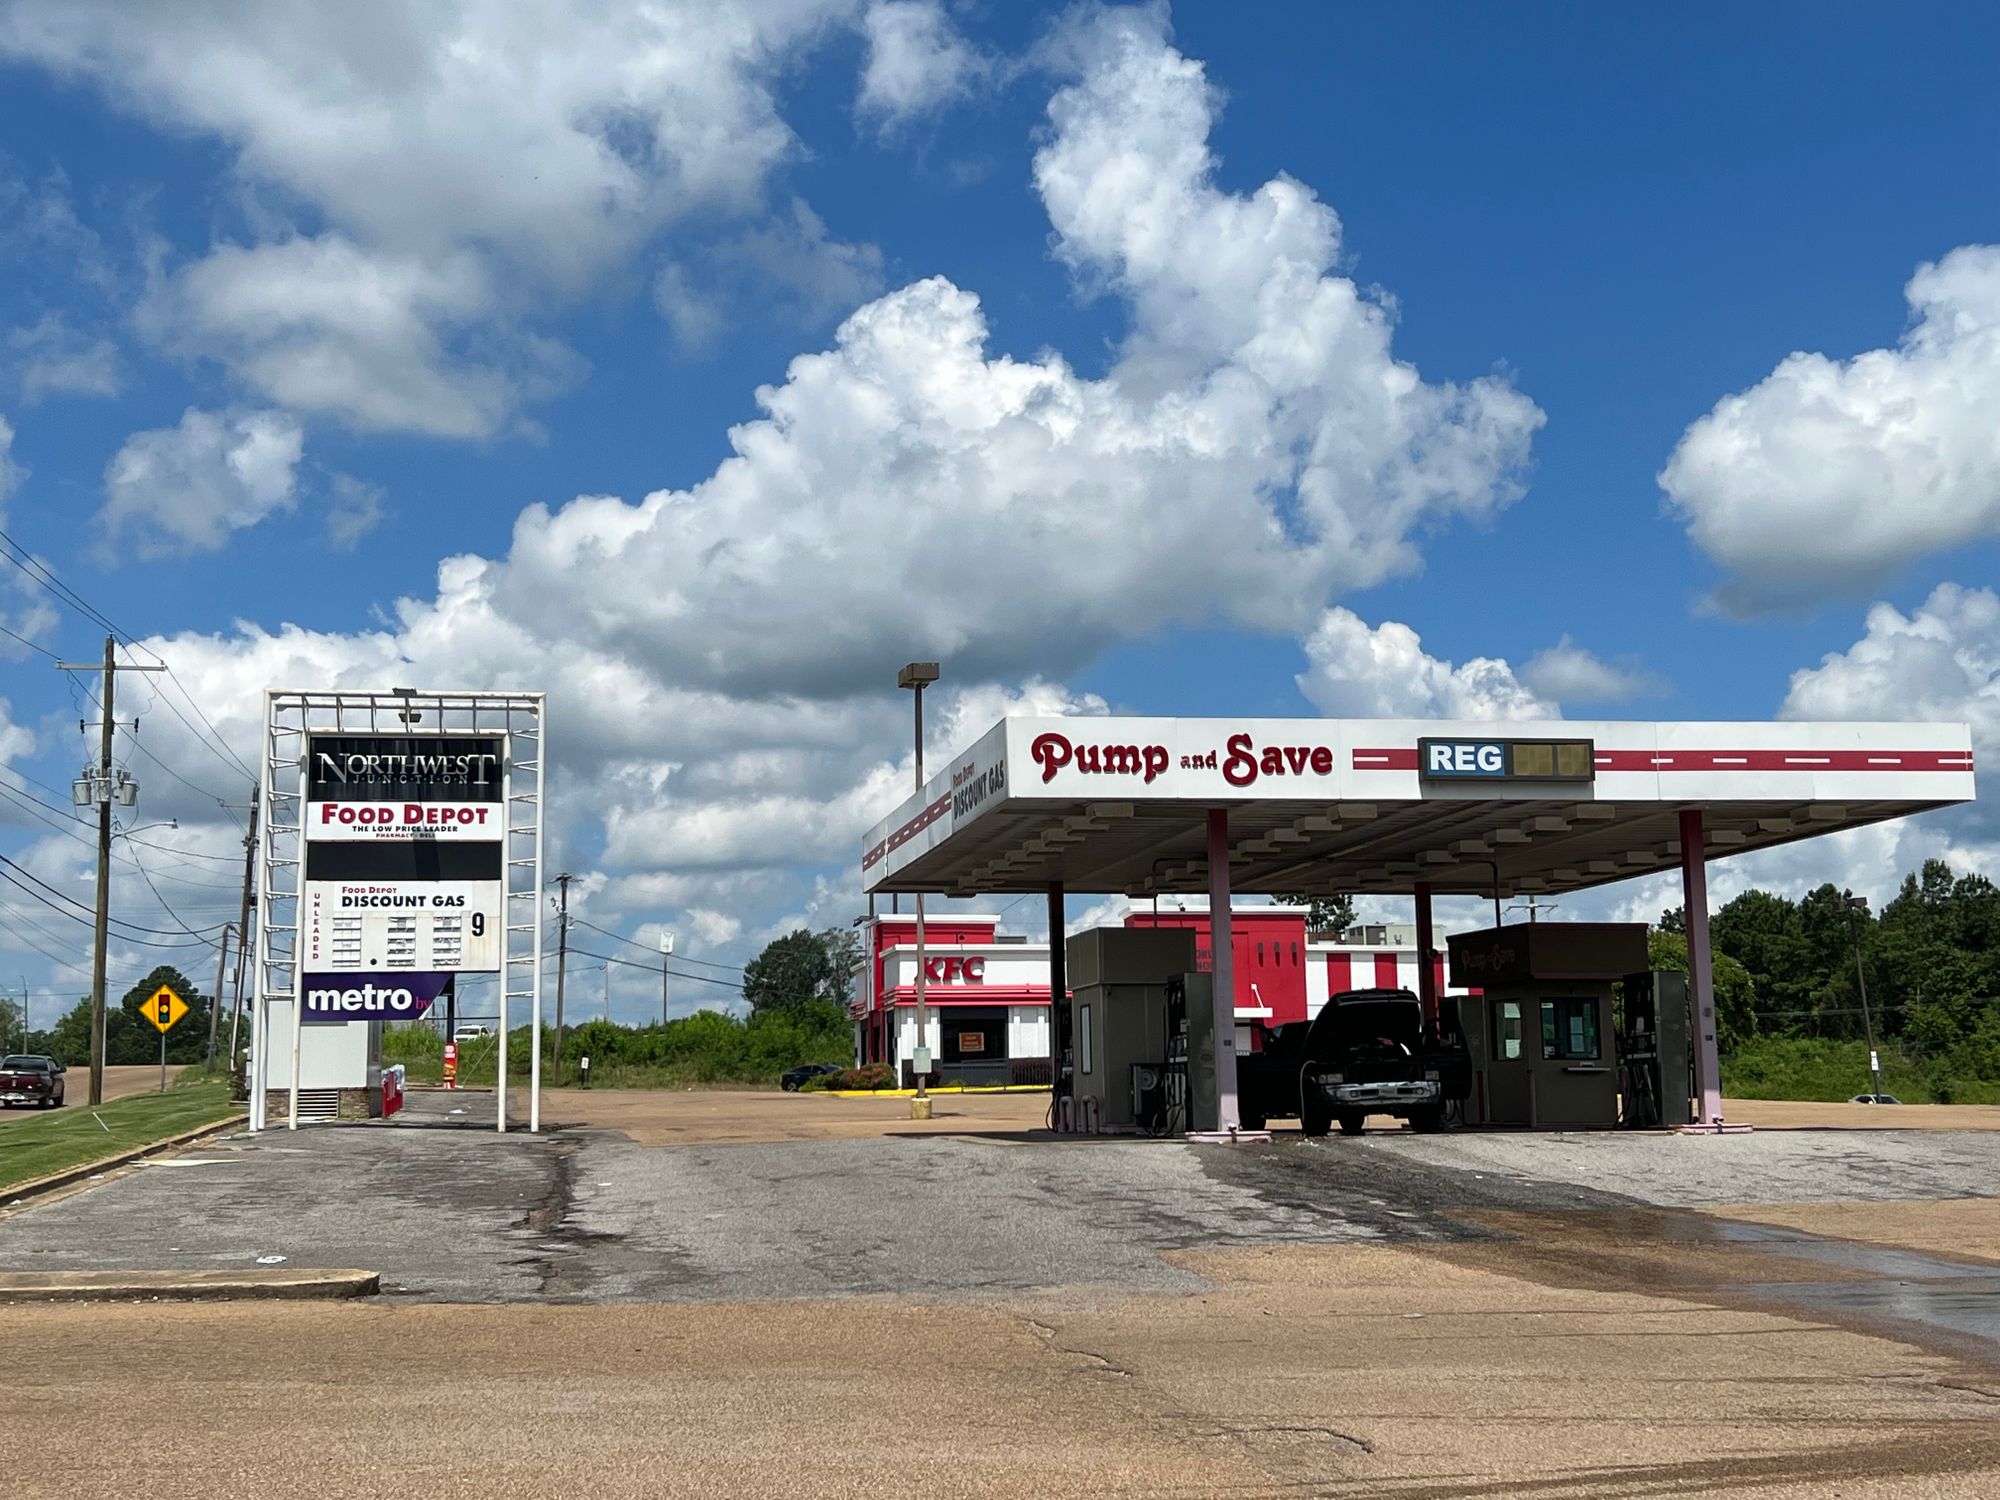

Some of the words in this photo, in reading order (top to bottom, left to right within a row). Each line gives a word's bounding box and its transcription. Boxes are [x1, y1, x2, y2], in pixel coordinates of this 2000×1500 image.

[316, 752, 497, 784] NORTHWEST
[1031, 732, 1170, 785] Pump
[1180, 749, 1218, 770] and
[1222, 732, 1333, 787] Save
[1430, 744, 1502, 771] REG
[953, 771, 987, 820] DISCOUNT
[988, 759, 1004, 795] GAS
[321, 803, 395, 825] FOOD
[403, 803, 489, 825] DEPOT
[341, 896, 427, 907] DISCOUNT
[432, 896, 465, 907] GAS
[342, 886, 366, 894] FOOD
[368, 886, 398, 894] DEPOT
[312, 892, 321, 960] UNLEADED
[471, 912, 485, 937] 9
[914, 956, 986, 983] KFC
[308, 983, 413, 1011] metro
